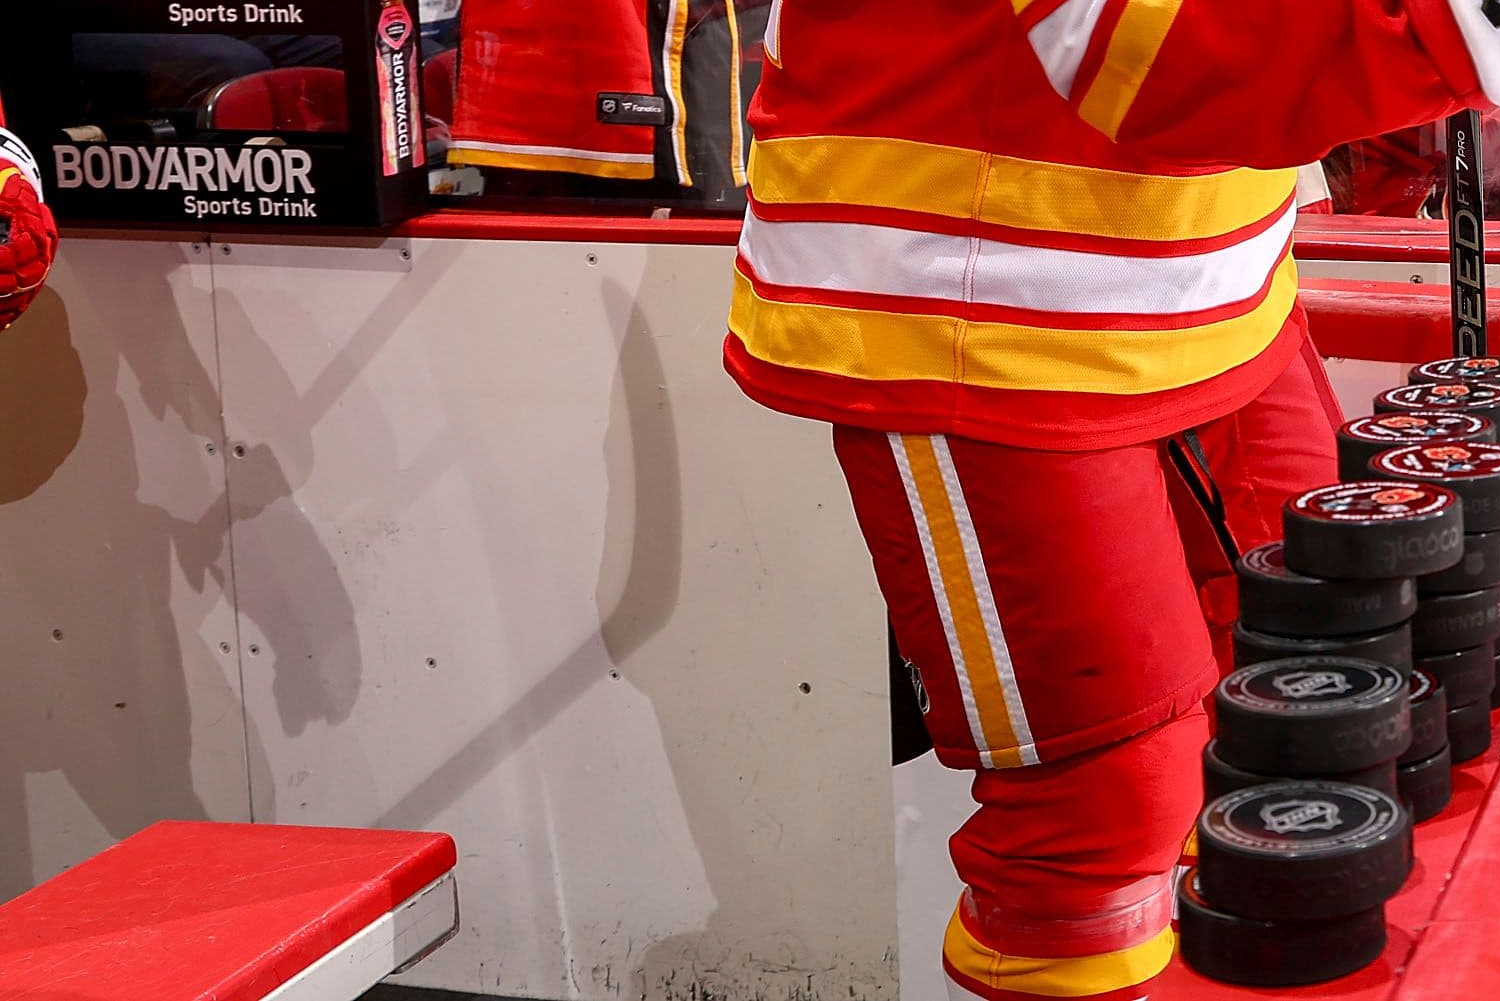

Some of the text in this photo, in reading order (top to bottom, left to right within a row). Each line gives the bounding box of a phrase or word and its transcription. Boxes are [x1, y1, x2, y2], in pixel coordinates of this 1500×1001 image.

[168, 2, 304, 27] Sports Drink
[393, 50, 410, 160] BODYARMOR
[631, 103, 662, 114] Fanatics
[53, 144, 316, 195] BODYARMOR
[183, 196, 317, 219] Sports Drink
